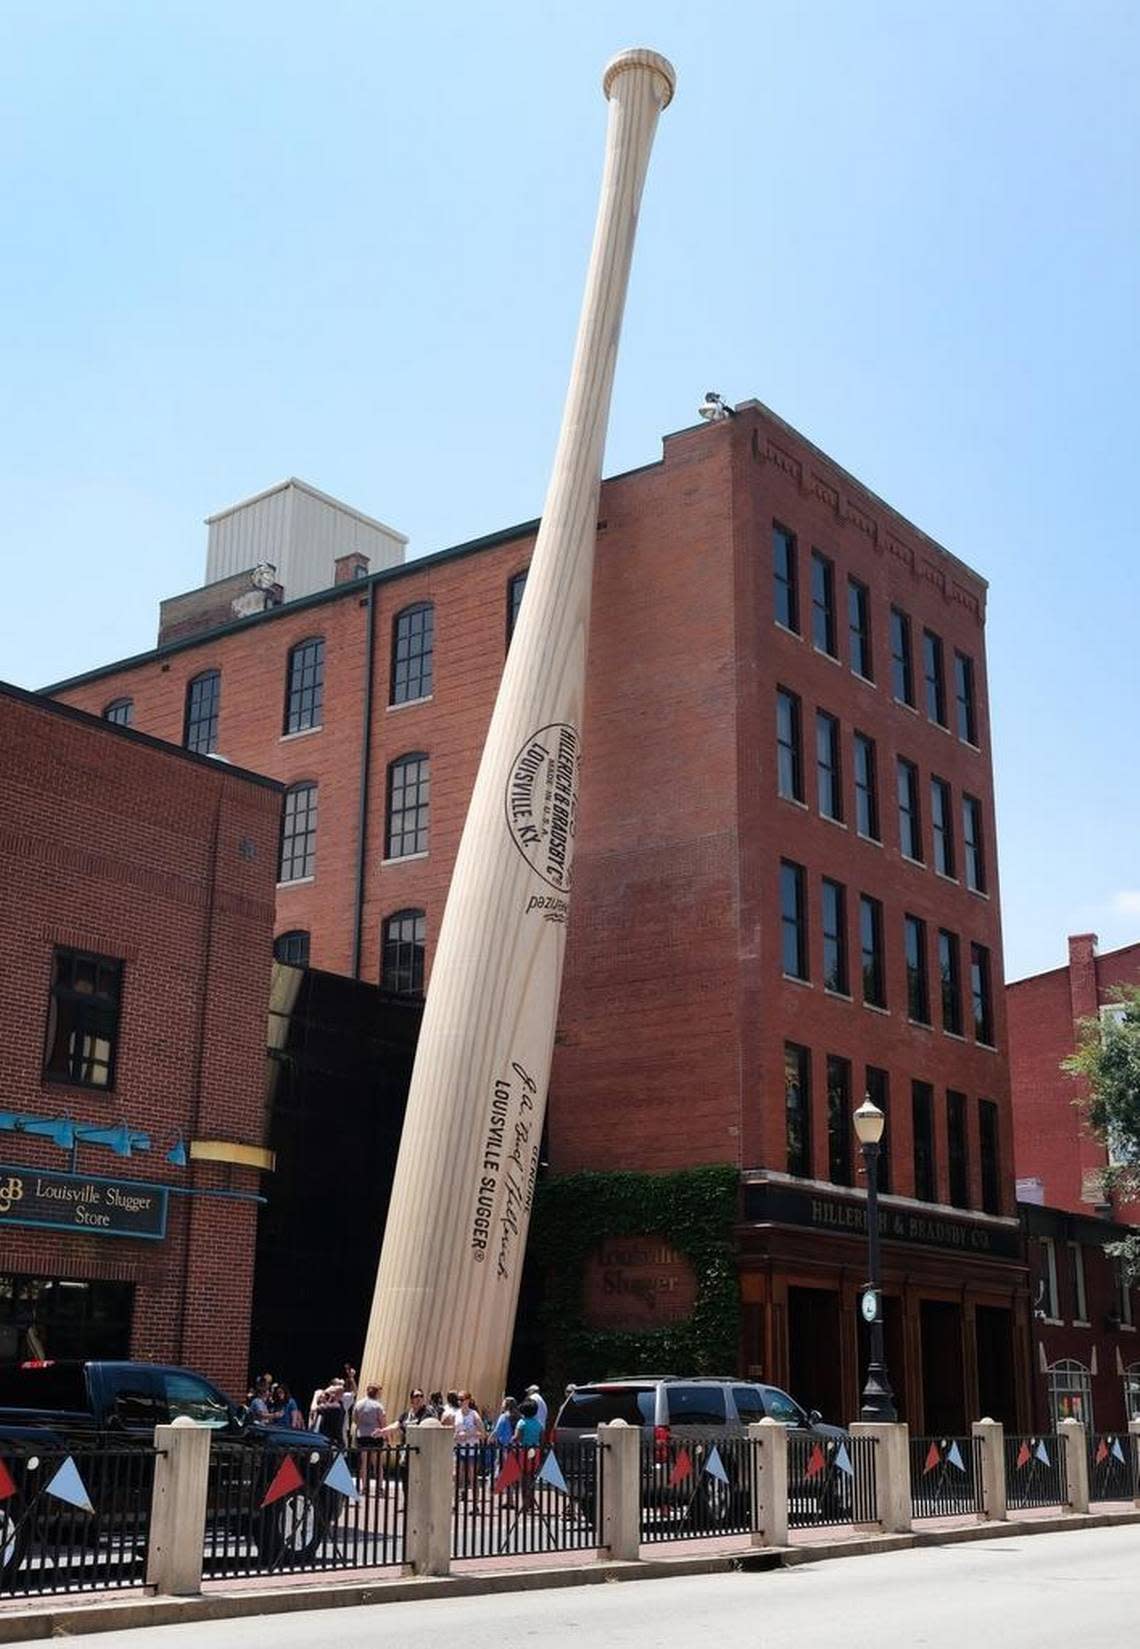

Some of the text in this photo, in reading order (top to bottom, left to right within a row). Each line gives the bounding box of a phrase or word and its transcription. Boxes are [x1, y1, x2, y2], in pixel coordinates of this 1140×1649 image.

[546, 758, 556, 785] MADE
[555, 728, 576, 797] HILLERICH
[544, 790, 553, 801] IN
[553, 792, 570, 808] &
[517, 824, 541, 848] KY.
[547, 804, 569, 870] BRADSBY
[483, 1079, 512, 1172] LOUISVILLE
[36, 1178, 152, 1212] Louisville Slugger
[75, 1204, 111, 1227] Store
[811, 1199, 888, 1234] HILLERIH
[893, 1213, 905, 1236] &
[909, 1216, 968, 1248] BRADSBY
